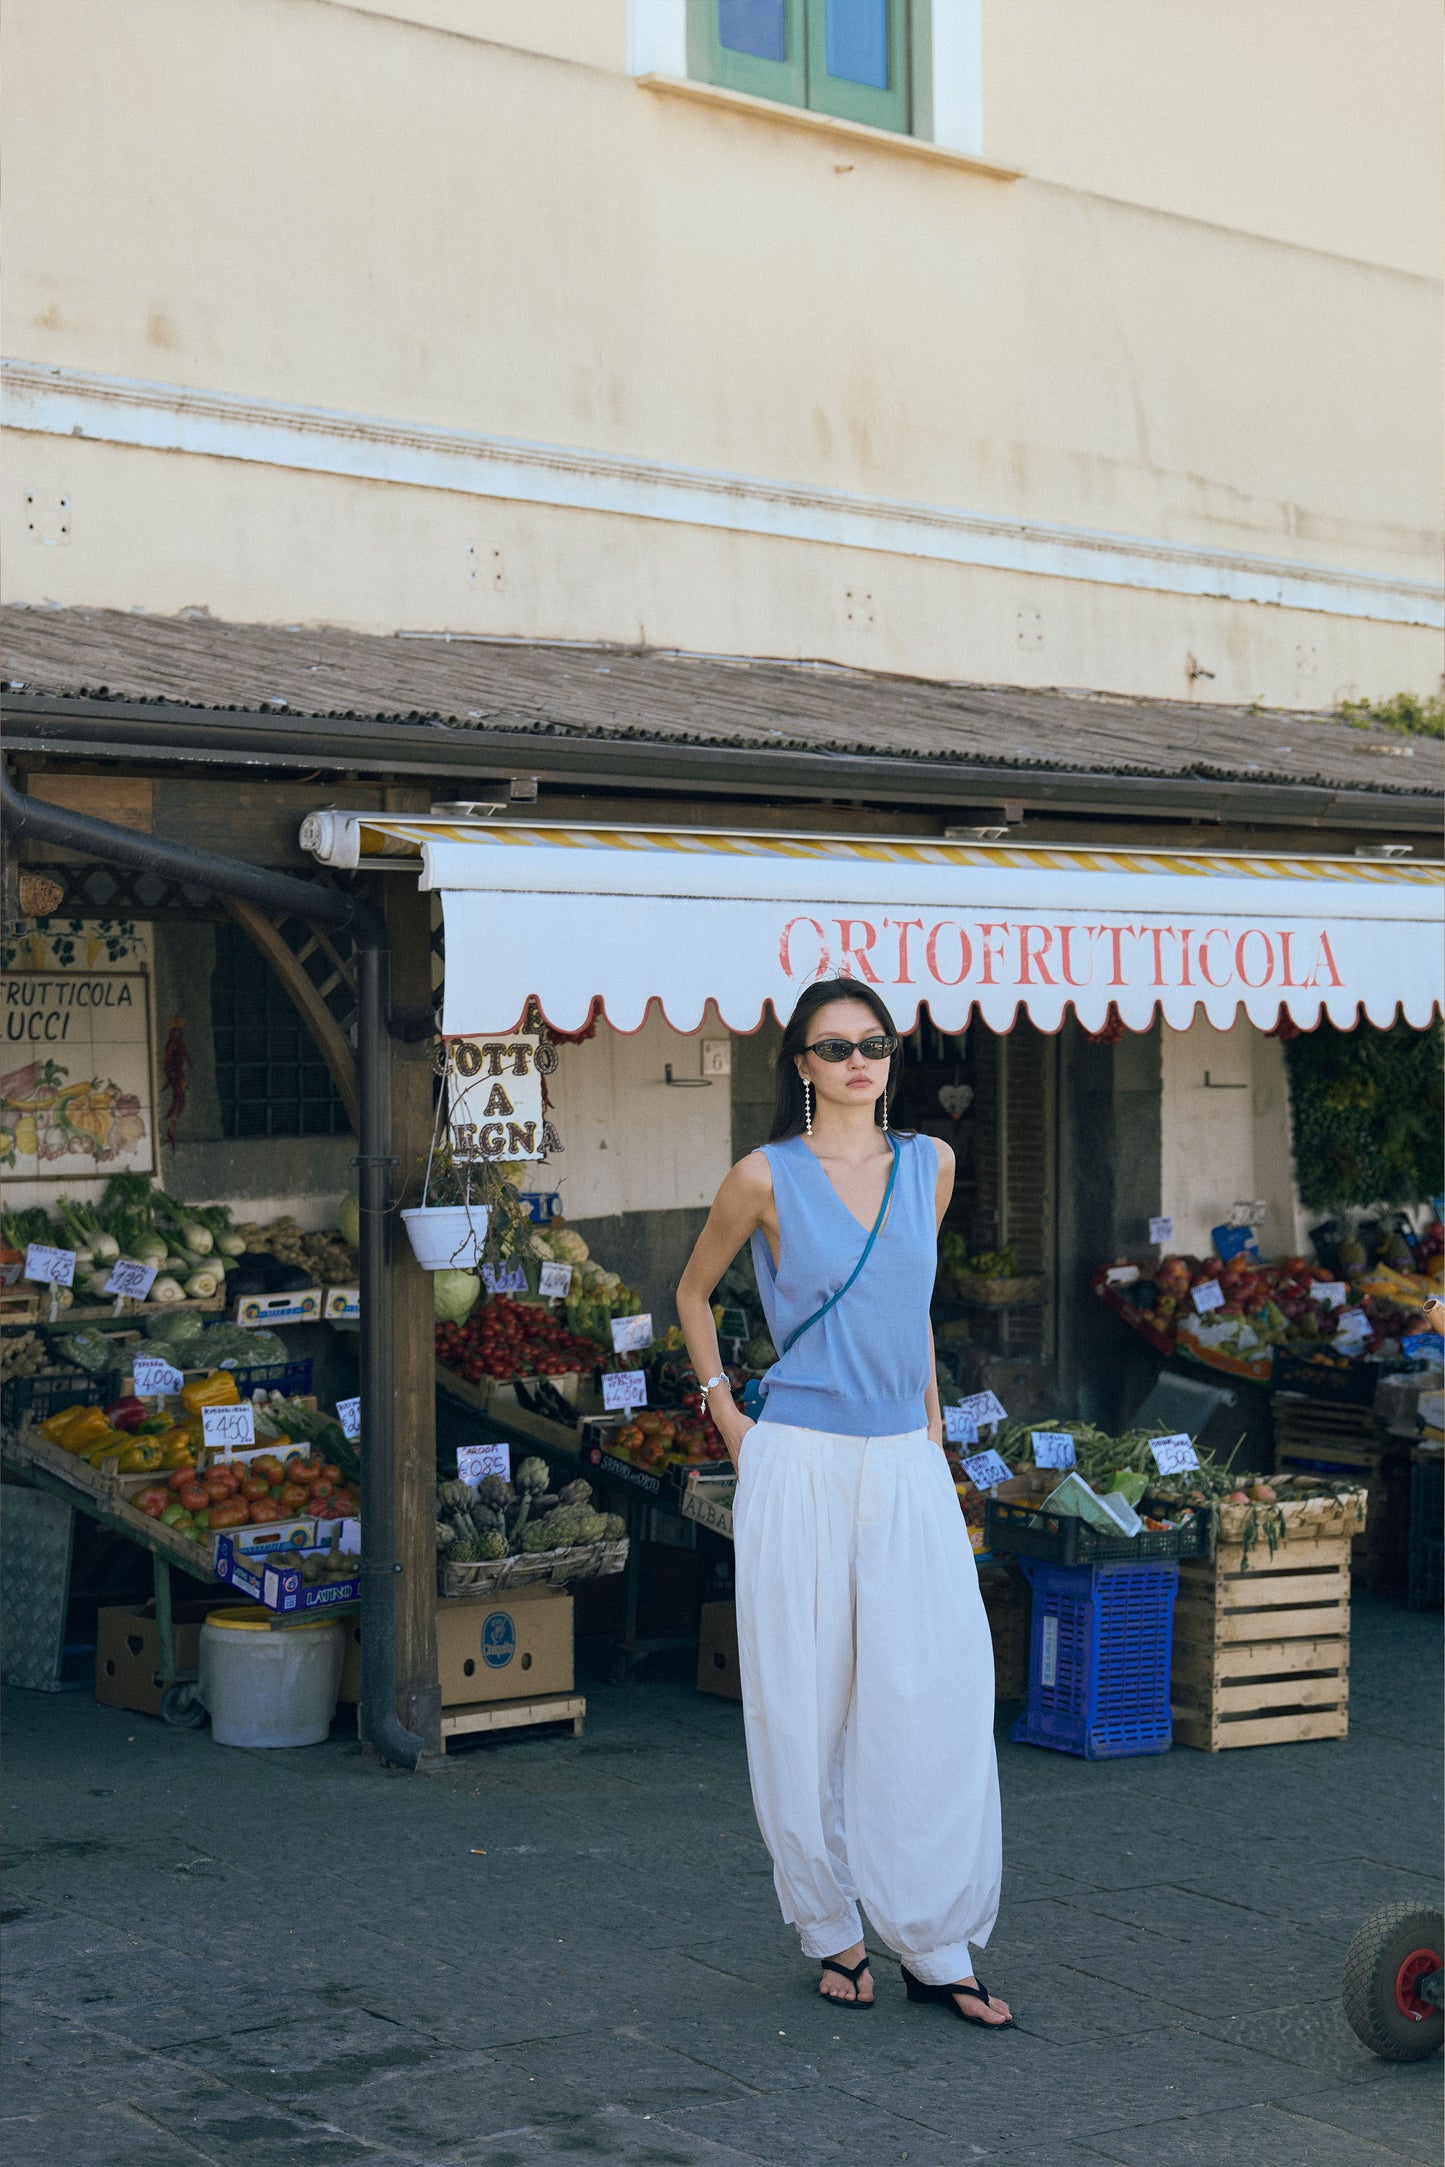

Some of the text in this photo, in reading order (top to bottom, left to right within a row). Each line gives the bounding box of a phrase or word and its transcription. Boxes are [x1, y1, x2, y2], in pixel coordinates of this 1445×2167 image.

[779, 916, 1347, 990] ORTOFRUTTICOLA
[432, 1042, 559, 1077] COTTO
[483, 1082, 514, 1117] A
